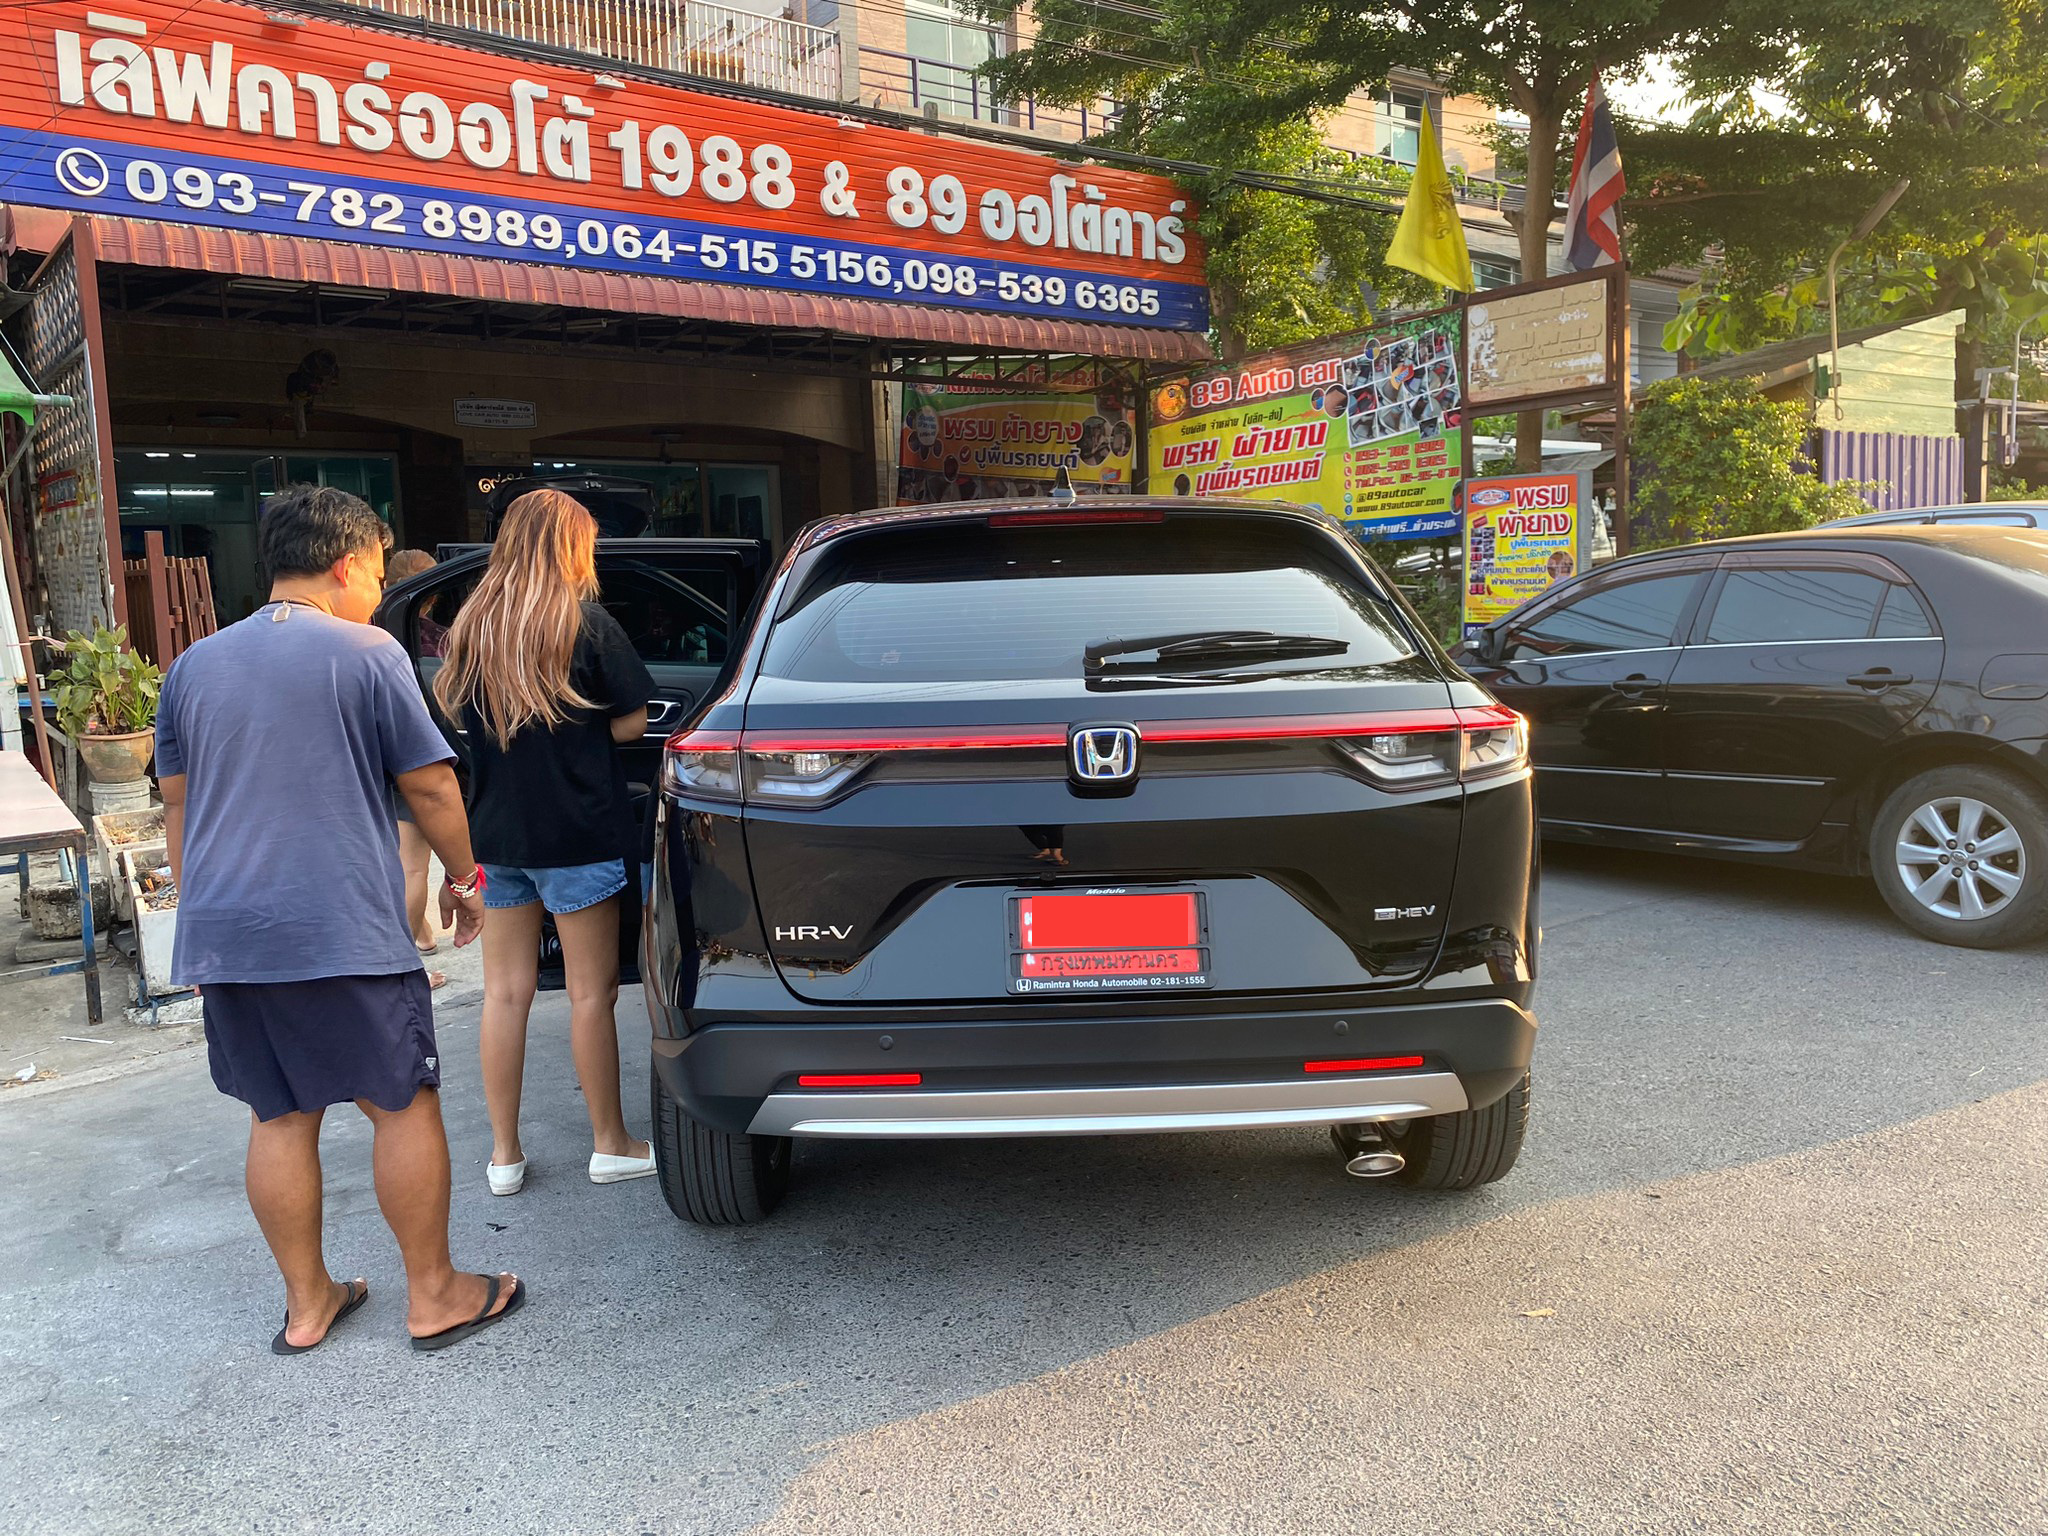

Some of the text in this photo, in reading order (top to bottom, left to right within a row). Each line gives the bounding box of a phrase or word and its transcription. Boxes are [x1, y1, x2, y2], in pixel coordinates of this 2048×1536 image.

[607, 119, 796, 210] 1988
[819, 160, 861, 219] &
[886, 166, 968, 235] 89
[978, 173, 1187, 265] ออโต้คาร์
[124, 159, 1161, 317] 093-782 8989,064-515 5156,098-539 6365
[1190, 358, 1342, 408] 89 Auto car
[944, 417, 995, 441] พรม
[1163, 420, 1328, 469] พรม ผ้ายาง
[1356, 487, 1427, 503] @89autocar
[1357, 498, 1445, 512] www.89autocar.com
[1514, 484, 1570, 510] พรม
[775, 925, 854, 941] HR-V
[1041, 954, 1178, 976] กรุงเทพมหานคร
[1033, 976, 1206, 989] Ramintra Honda Automobile 02-181-1555
